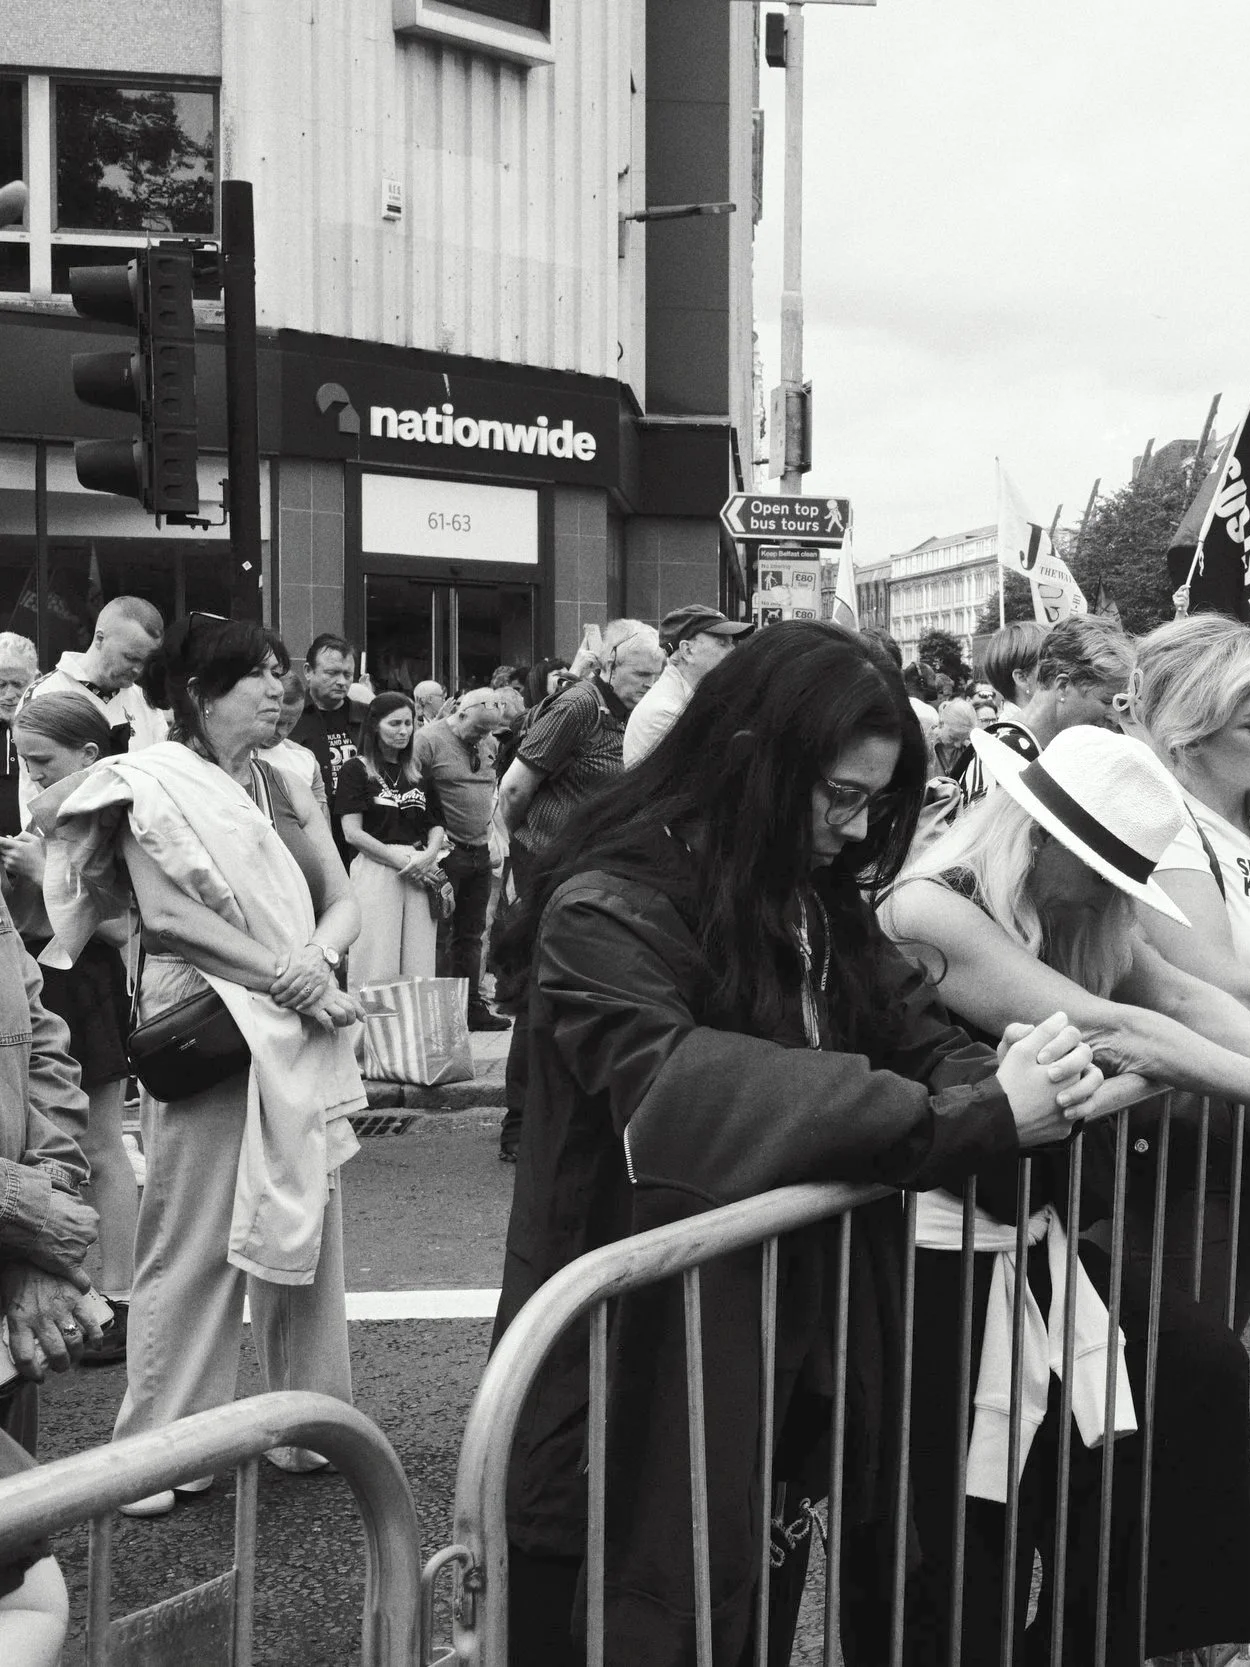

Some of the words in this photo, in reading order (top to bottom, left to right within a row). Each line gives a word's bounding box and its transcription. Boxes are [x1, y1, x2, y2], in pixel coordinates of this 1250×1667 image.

[370, 403, 597, 461] nationwide
[751, 501, 789, 516] Open
[795, 503, 819, 518] top
[428, 512, 472, 532] 61-63
[750, 517, 776, 530] bus
[781, 518, 820, 532] tours
[761, 550, 778, 558] Keep
[795, 573, 813, 583] £80
[1040, 566, 1057, 579] THE
[795, 611, 813, 619] £80
